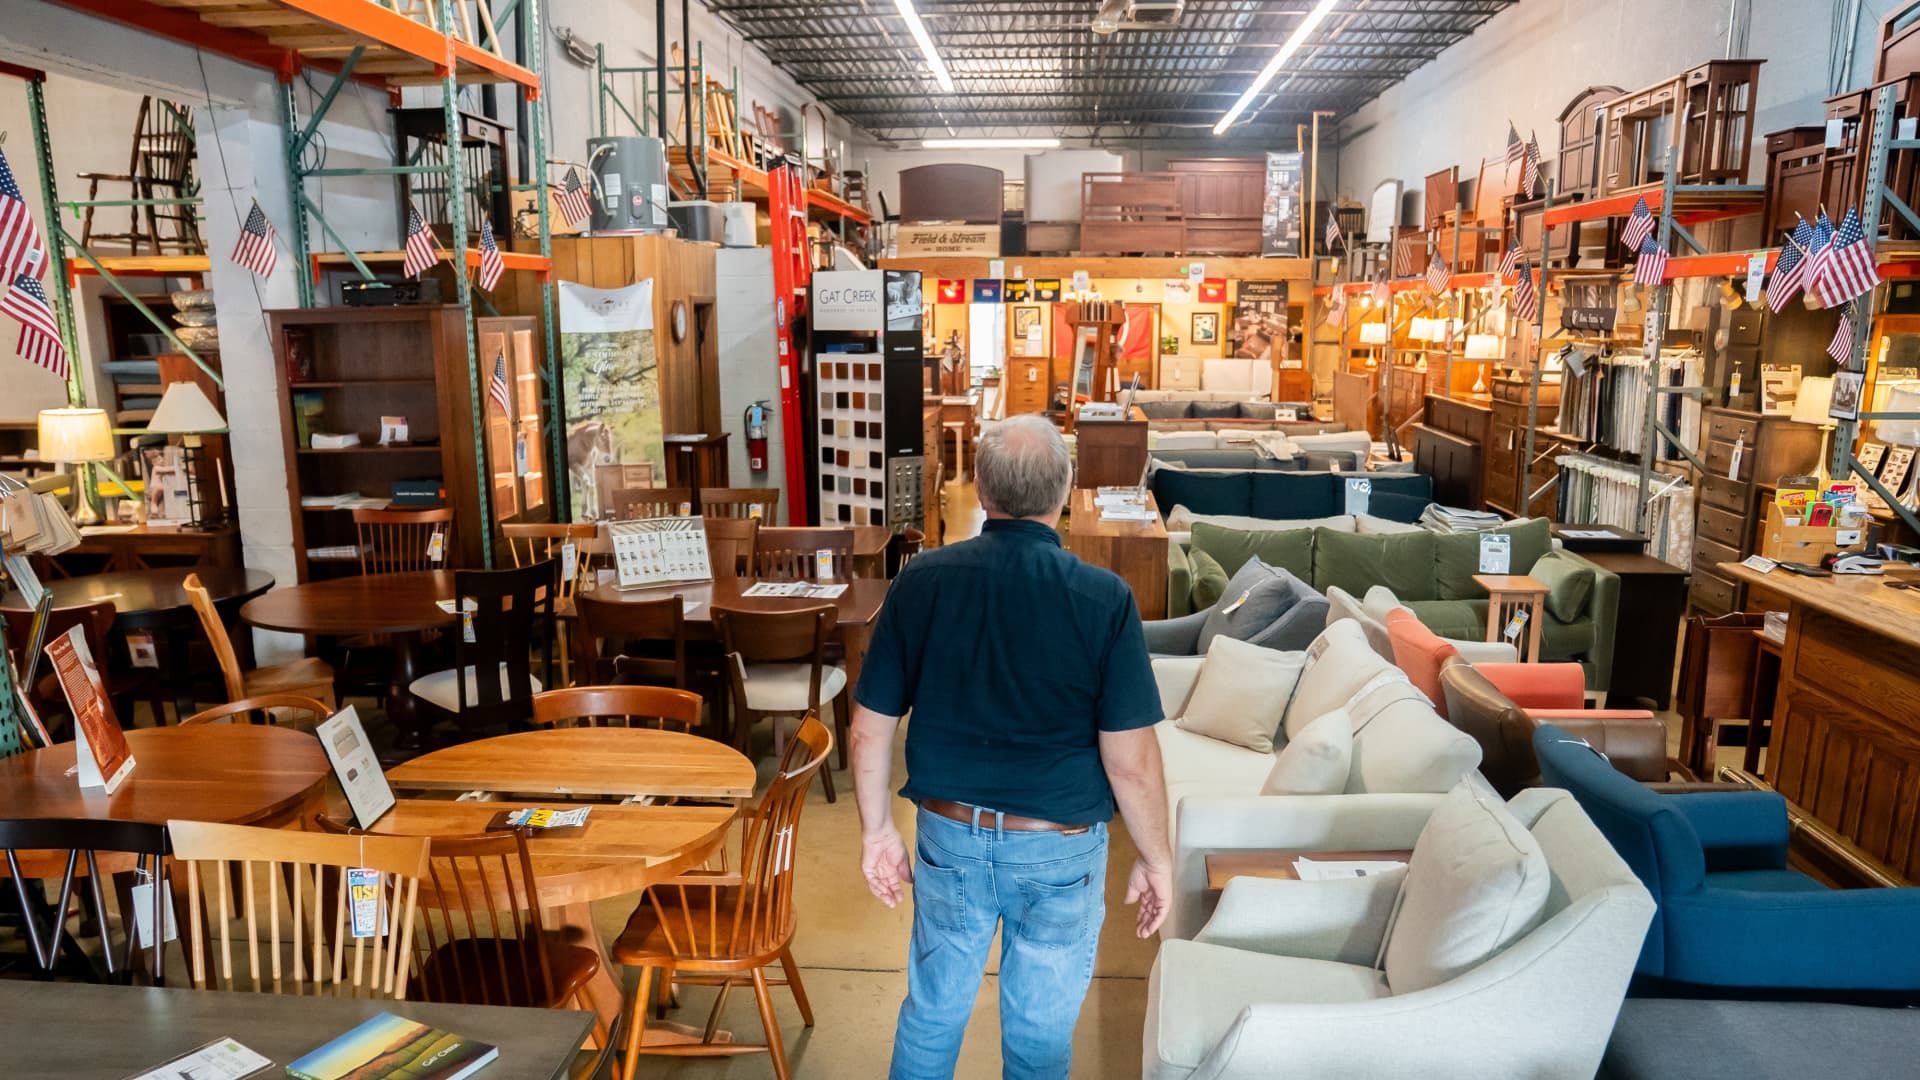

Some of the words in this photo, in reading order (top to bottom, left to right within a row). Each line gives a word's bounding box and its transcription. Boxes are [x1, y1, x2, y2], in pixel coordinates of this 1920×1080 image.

[911, 233, 938, 244] Field
[940, 233, 947, 244] &
[949, 233, 987, 244] Stream
[819, 289, 841, 304] GAT
[843, 288, 877, 304] CREEK
